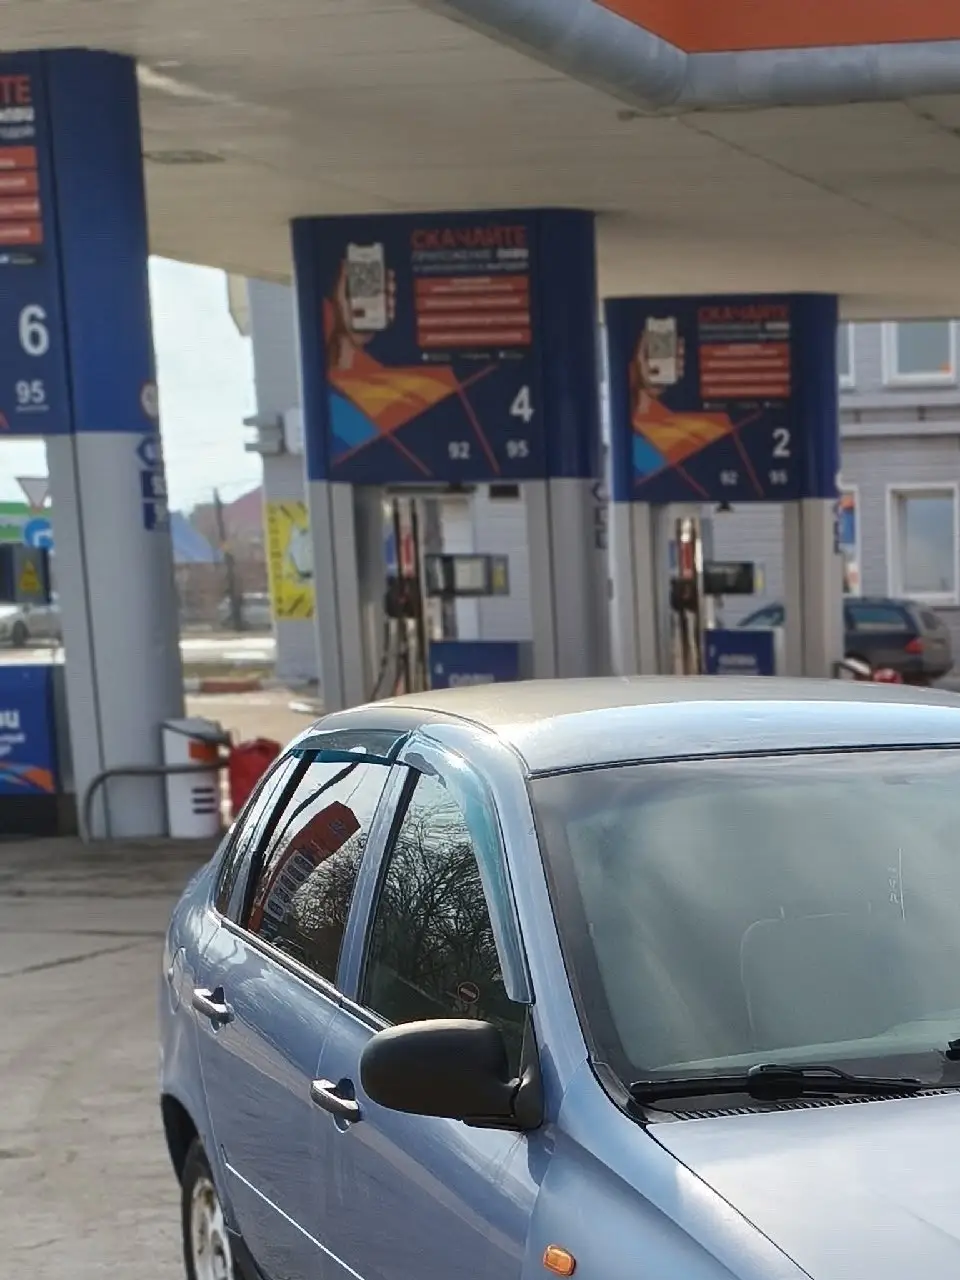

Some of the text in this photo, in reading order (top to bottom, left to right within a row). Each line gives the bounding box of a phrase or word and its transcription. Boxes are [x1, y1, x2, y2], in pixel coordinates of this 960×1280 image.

[18, 304, 49, 356] 6
[16, 381, 46, 404] 95
[509, 385, 534, 423] 4
[448, 441, 471, 460] 92
[506, 439, 529, 459] 95
[772, 428, 791, 458] 2
